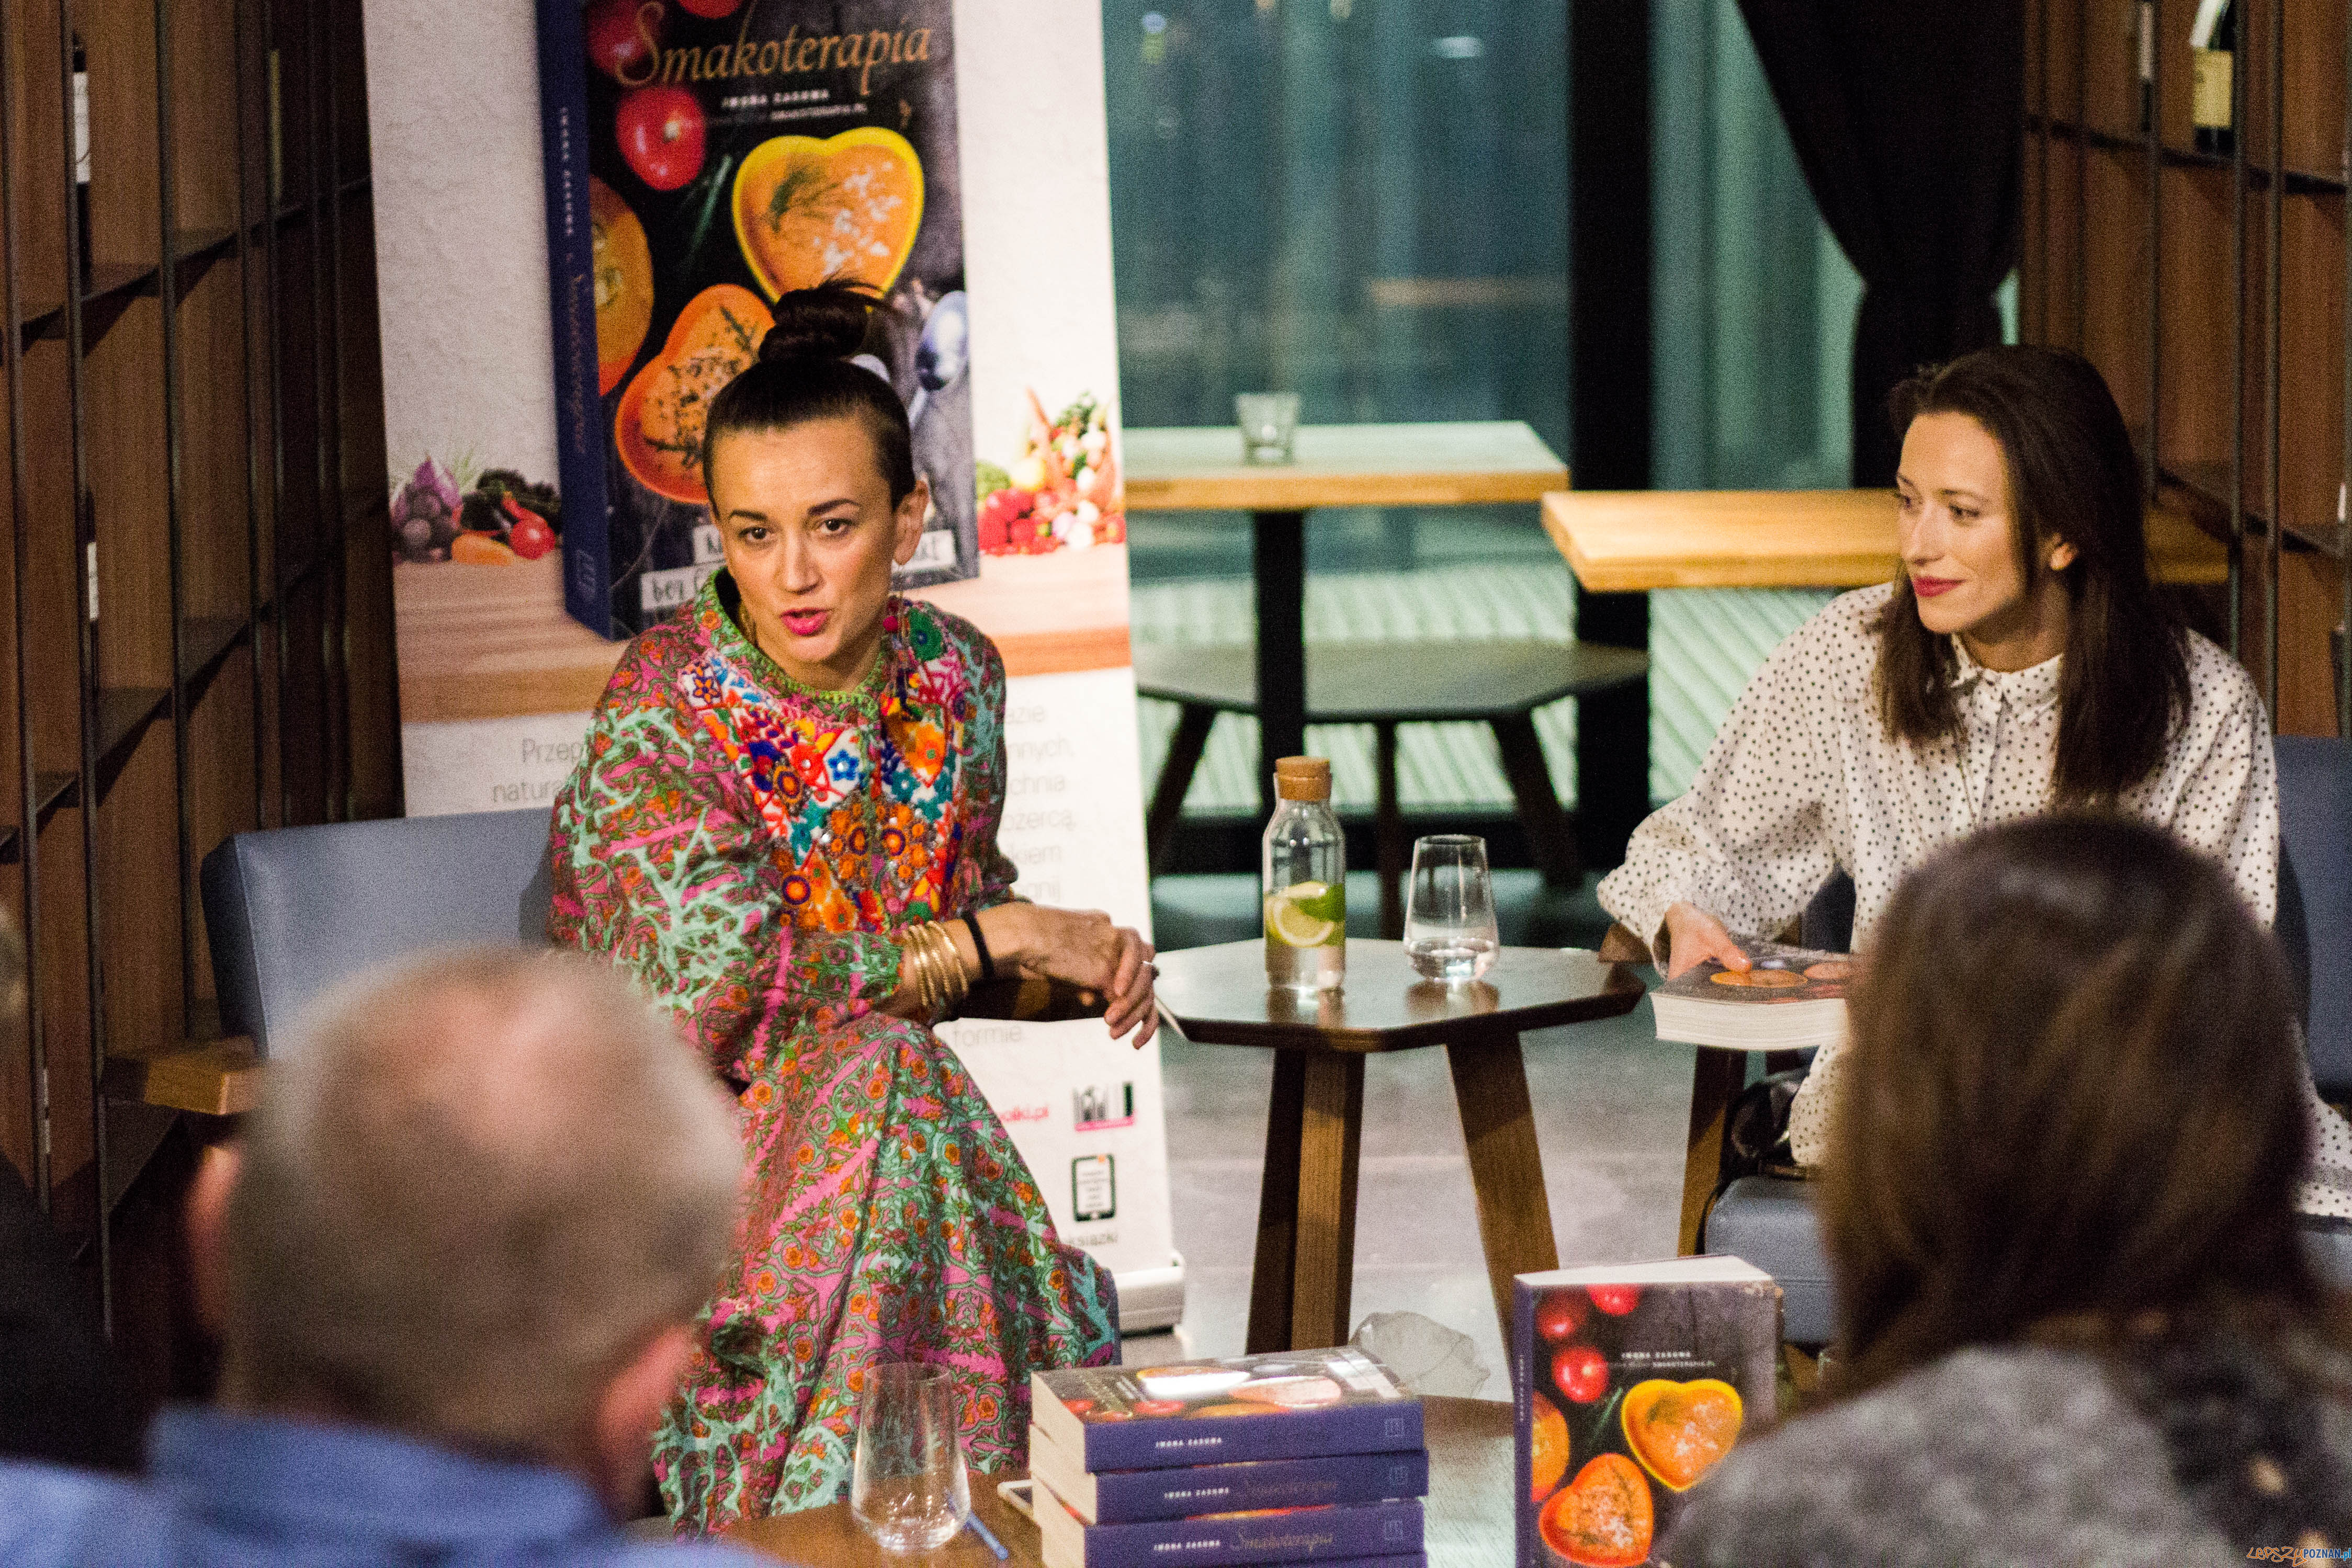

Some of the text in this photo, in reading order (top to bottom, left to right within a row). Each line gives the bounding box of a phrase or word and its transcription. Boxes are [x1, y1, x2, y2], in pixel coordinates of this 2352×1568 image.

[616, 0, 932, 95] Smakoterapia
[493, 734, 1076, 803] natura nnych,
[523, 738, 584, 764] Przep
[1009, 773, 1066, 796] chnia
